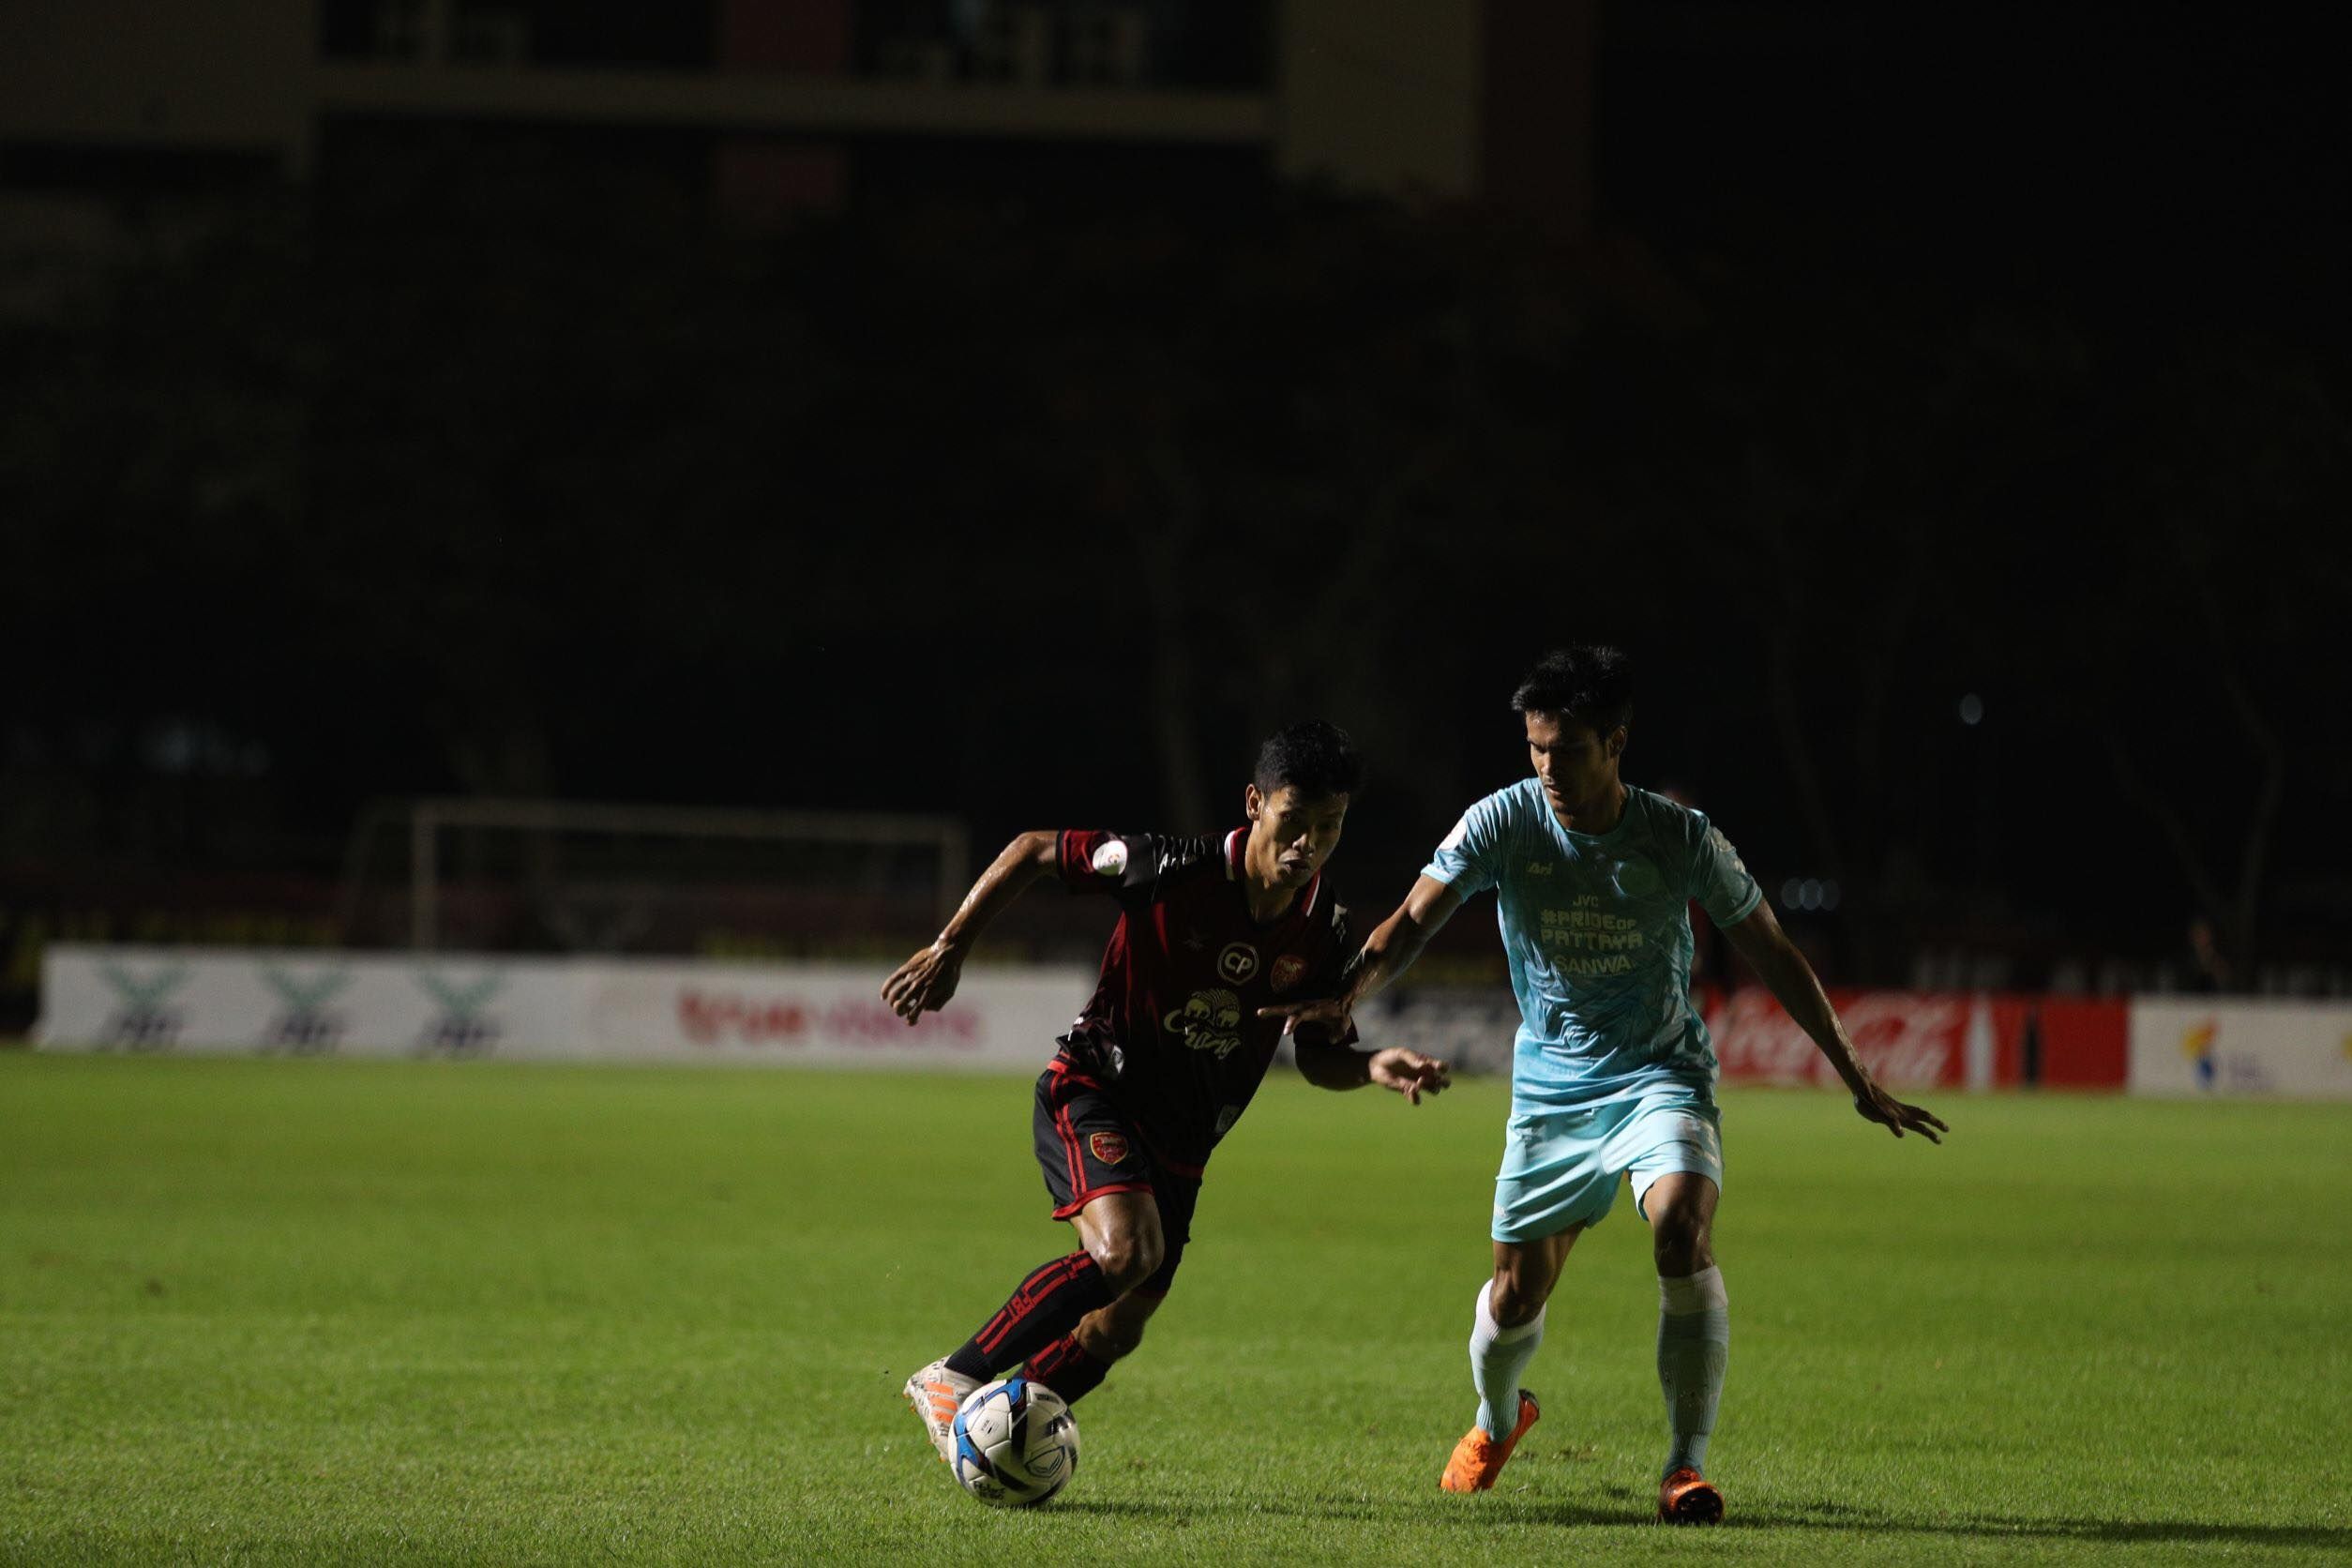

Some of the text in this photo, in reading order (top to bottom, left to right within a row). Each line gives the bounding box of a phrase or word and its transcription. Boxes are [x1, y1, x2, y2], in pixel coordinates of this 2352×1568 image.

[1573, 894, 1599, 908] JVC
[1541, 929, 1644, 950] PATTAYA
[1224, 951, 1254, 975] CP
[1554, 954, 1633, 973] SANWA
